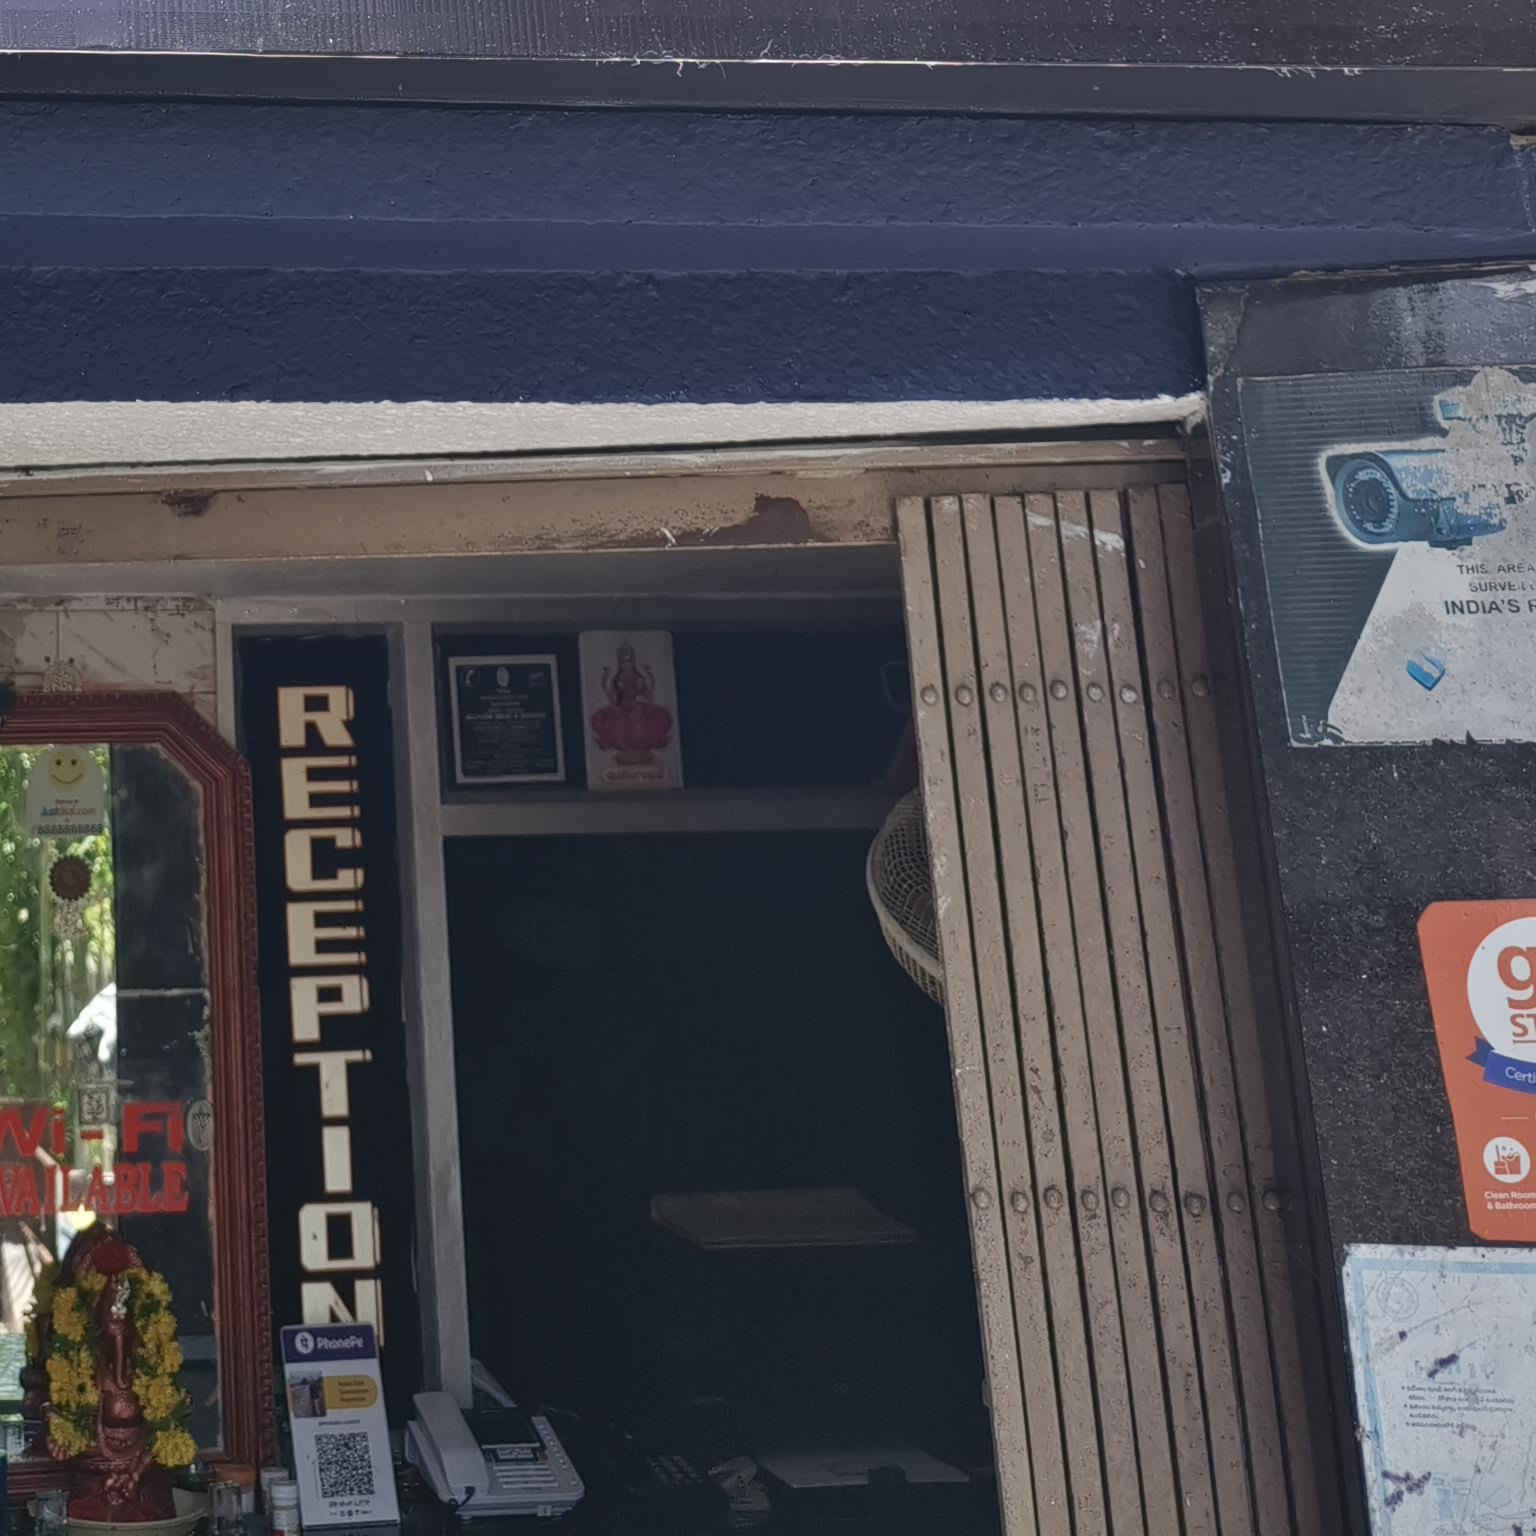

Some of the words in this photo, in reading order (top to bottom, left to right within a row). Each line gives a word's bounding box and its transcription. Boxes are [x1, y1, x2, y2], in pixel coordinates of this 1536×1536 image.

[1457, 564, 1488, 575] THIS
[1497, 563, 1536, 574] AREA
[1444, 599, 1521, 615] INDIA'S
[316, 1336, 365, 1350] PhonePe
